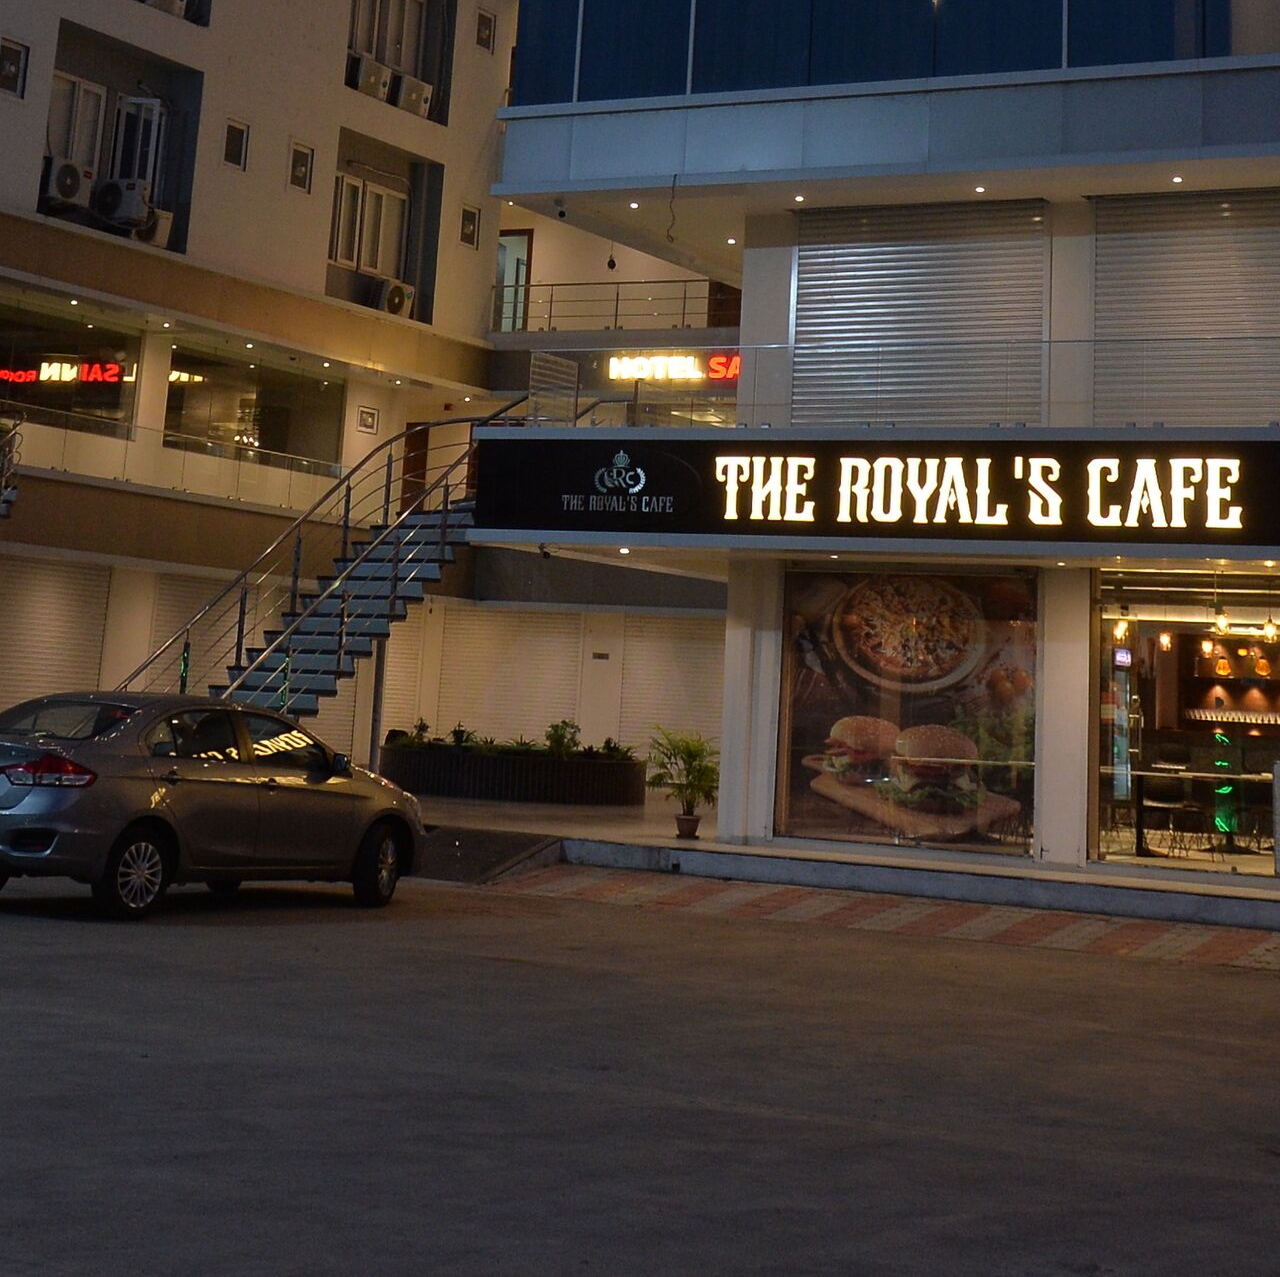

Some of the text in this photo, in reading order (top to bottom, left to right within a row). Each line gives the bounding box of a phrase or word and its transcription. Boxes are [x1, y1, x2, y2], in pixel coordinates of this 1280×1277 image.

[608, 355, 742, 381] HOTEL SA
[561, 494, 674, 513] THE ROYAL'S CAFE
[715, 454, 1244, 530] THE ROYAL'S CAFE
